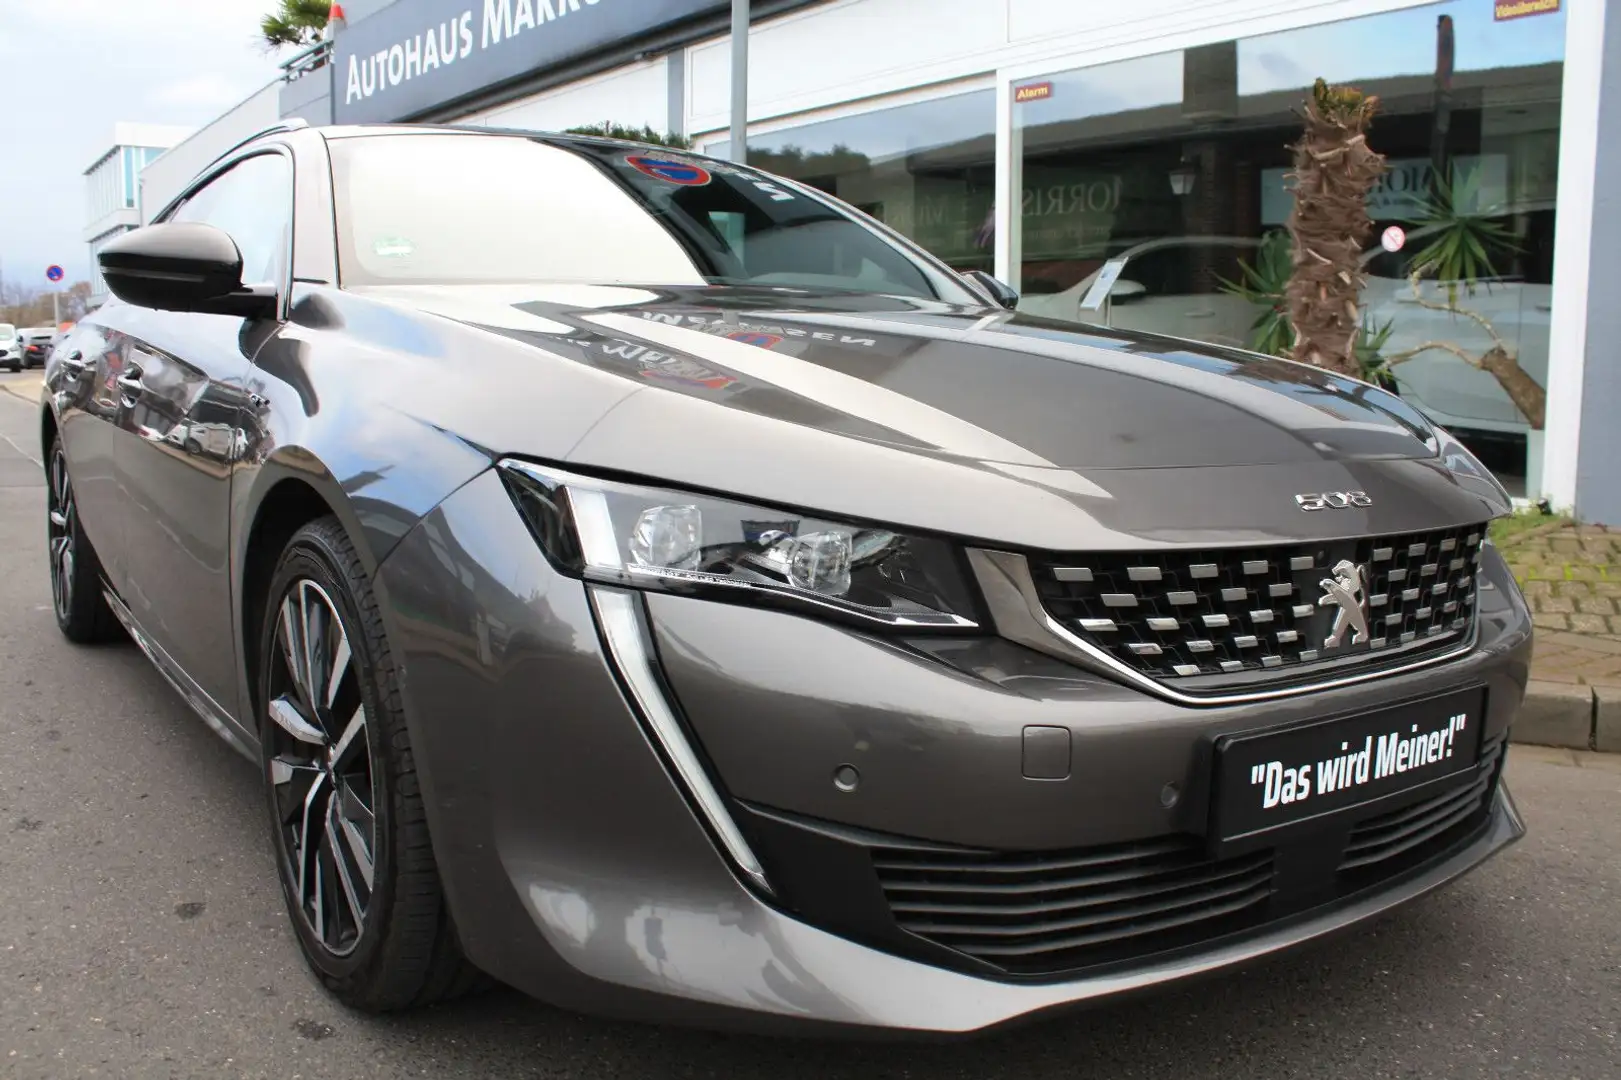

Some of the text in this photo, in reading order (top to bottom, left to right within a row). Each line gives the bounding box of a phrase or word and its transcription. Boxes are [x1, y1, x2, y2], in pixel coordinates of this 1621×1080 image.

[345, 10, 473, 105] AUTOHAUS
[1016, 85, 1049, 101] Alarm
[1295, 490, 1373, 511] 508
[1251, 713, 1467, 809] "Das wird Meiner!"
